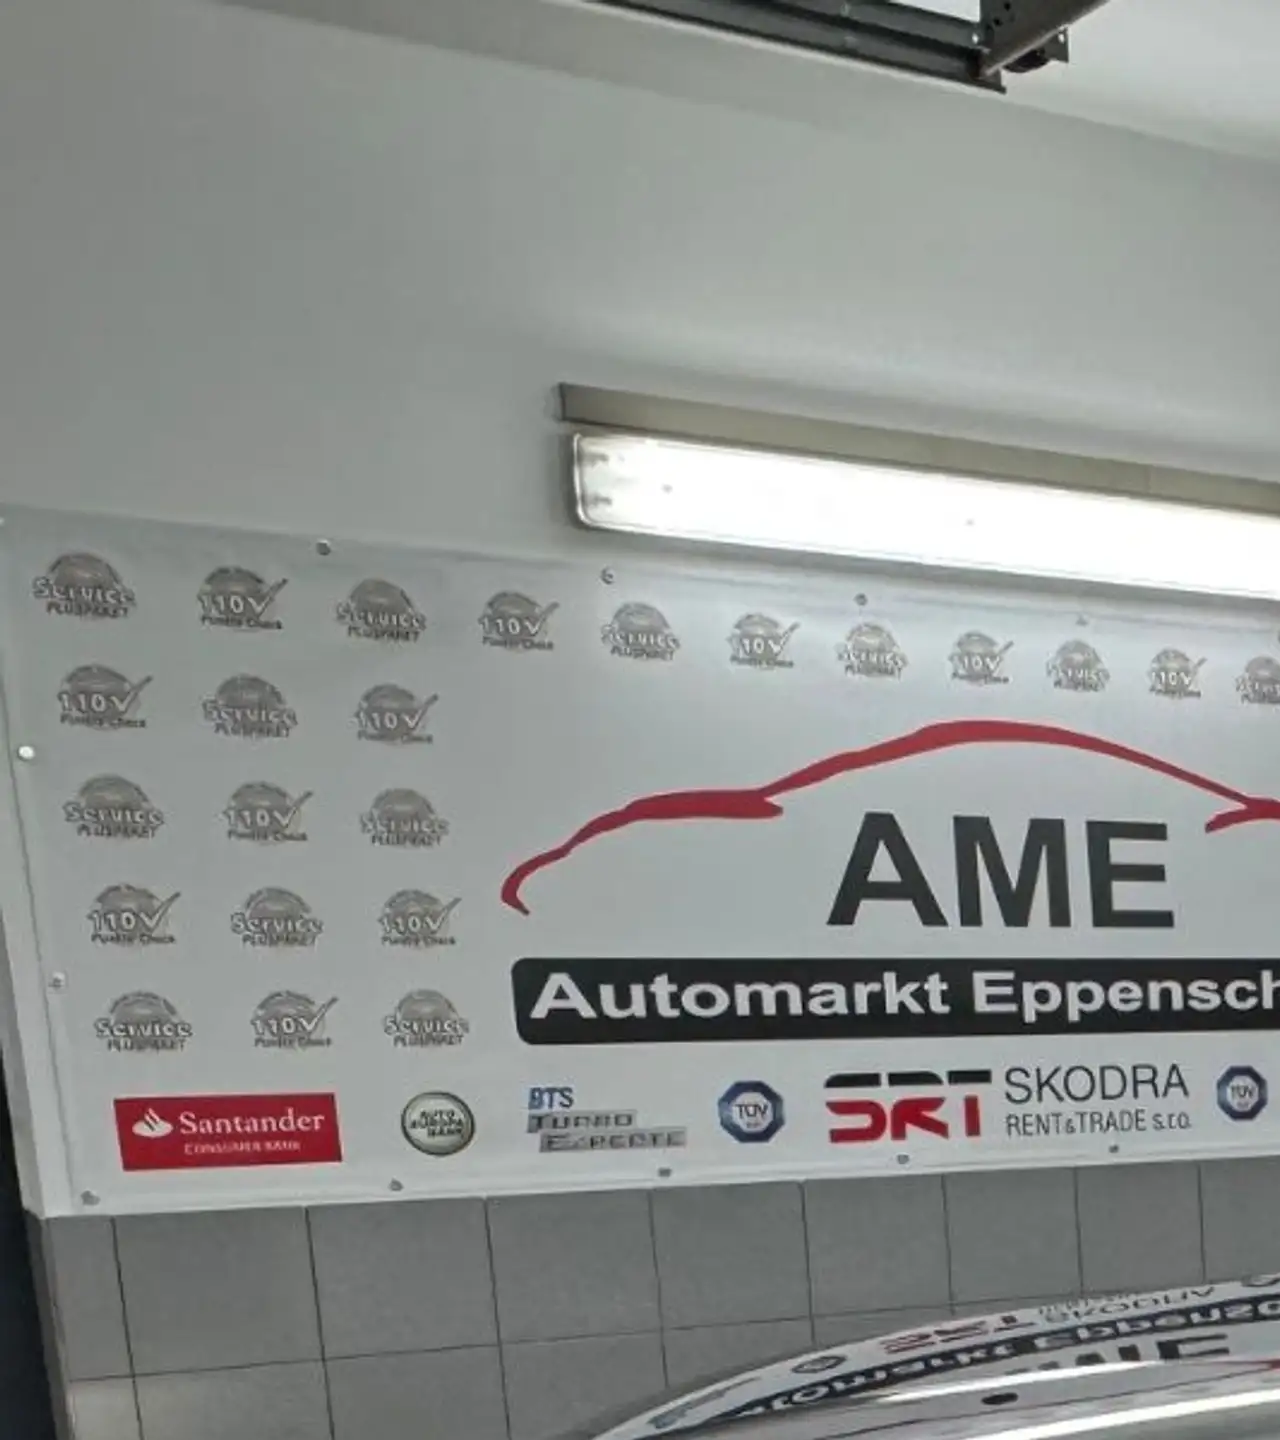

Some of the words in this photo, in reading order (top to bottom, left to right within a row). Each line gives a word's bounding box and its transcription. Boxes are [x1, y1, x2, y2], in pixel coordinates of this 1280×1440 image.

[826, 811, 1175, 929] AME
[530, 970, 949, 1020] Automarkt
[529, 1087, 574, 1110] BTS
[1004, 1063, 1190, 1105] SKODRA
[178, 1107, 325, 1135] Santander
